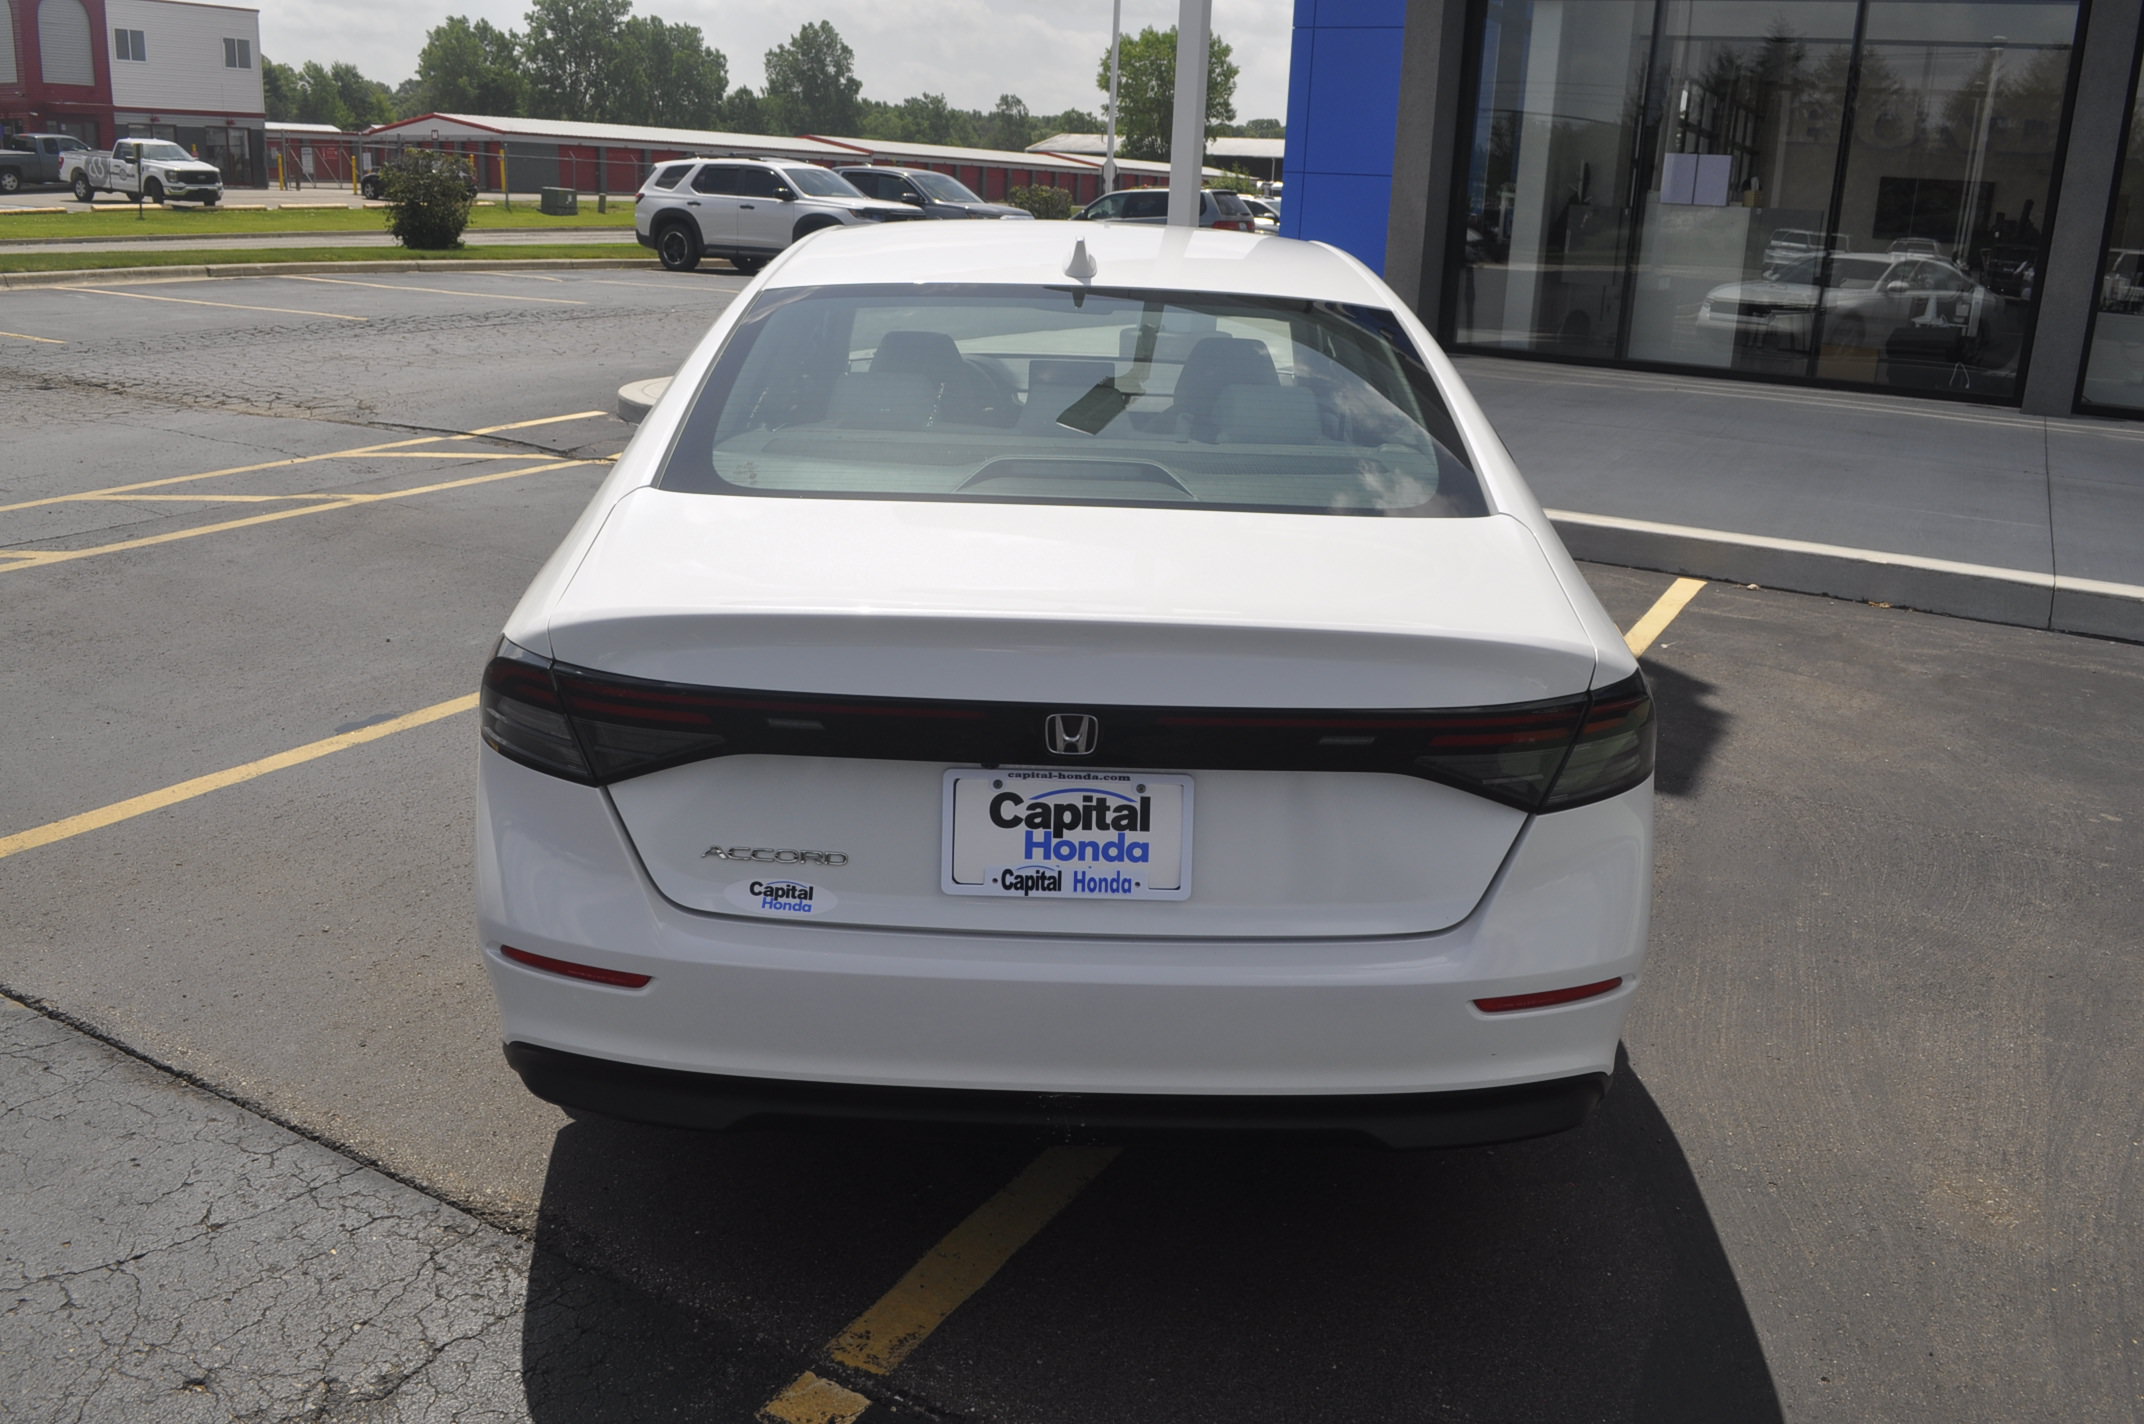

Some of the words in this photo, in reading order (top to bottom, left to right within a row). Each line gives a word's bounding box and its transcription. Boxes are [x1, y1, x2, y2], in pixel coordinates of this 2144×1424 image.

[1007, 771, 1131, 782] capital-honda.com
[989, 791, 1151, 838] Capital
[701, 845, 849, 866] ACCORD
[1024, 830, 1149, 863] Honda
[749, 881, 814, 901] Capital
[1001, 868, 1062, 896] Capital
[1072, 870, 1132, 894] Honda
[761, 896, 812, 913] Honda
